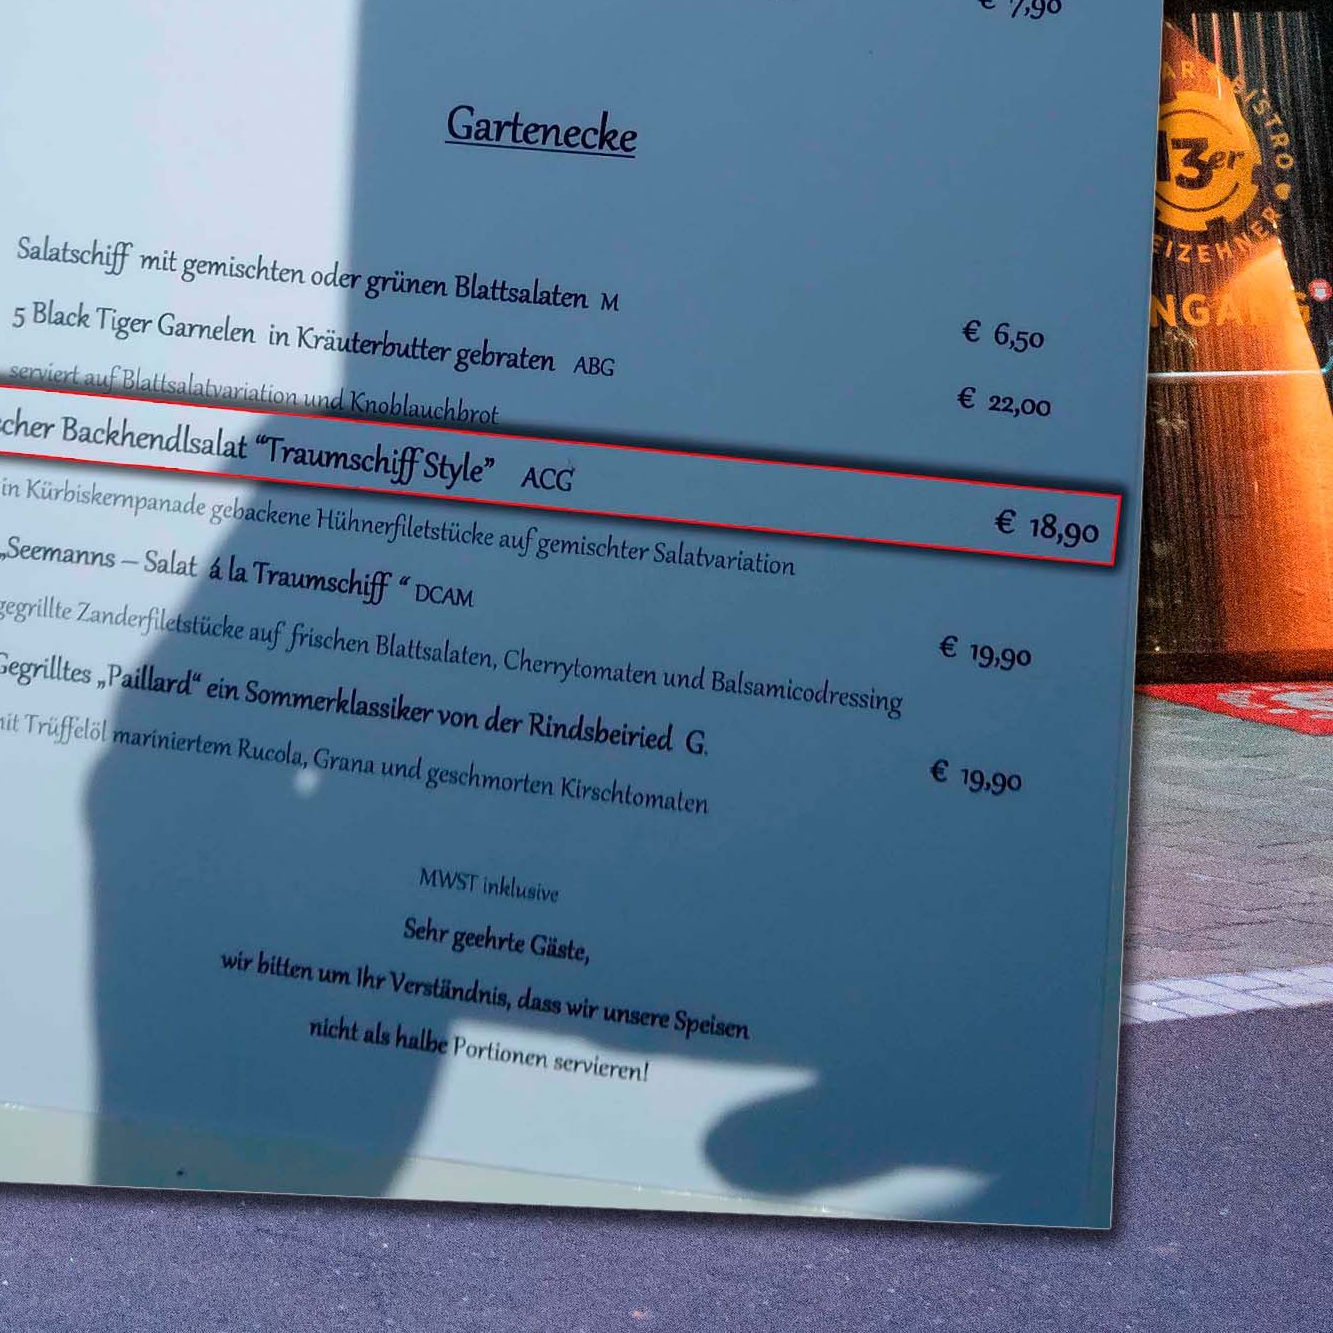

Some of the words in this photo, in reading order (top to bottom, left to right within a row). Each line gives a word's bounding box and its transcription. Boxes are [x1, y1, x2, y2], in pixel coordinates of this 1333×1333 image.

[1162, 60, 1196, 79] AR
[445, 104, 638, 156] Gartenecke
[17, 234, 134, 277] Salatschiff
[139, 249, 178, 272] mit
[180, 254, 306, 285] gemischten
[310, 260, 363, 289] oder
[364, 270, 449, 300] grünen
[454, 272, 590, 309] Blattsalaten
[600, 292, 620, 312] M
[12, 307, 26, 329] 5
[32, 298, 91, 329] Black
[95, 306, 153, 341] Tiger
[157, 312, 257, 344] Garnelen
[268, 323, 291, 347] in
[296, 325, 453, 362] Kräuterbutter
[453, 338, 557, 373] gebraten
[572, 355, 616, 377] ABG
[961, 319, 982, 343] €
[994, 322, 1045, 354] 6,50
[9, 360, 80, 387] serviert
[83, 363, 122, 394] auf
[122, 368, 298, 407] Blattsalatvariation
[303, 387, 344, 412] und
[350, 390, 501, 426] Knoblauchbrot
[956, 386, 977, 410] €
[988, 394, 1052, 418] 22,00
[61, 416, 248, 460] Backhendlsalat
[520, 466, 576, 492] ACG
[1, 477, 21, 498] in
[26, 478, 206, 517] Kürbiskernpanade
[209, 497, 311, 527] gebackene
[316, 507, 495, 549] Hühnerfiletstücke
[499, 527, 538, 558] auf
[535, 533, 651, 563] gemischter
[653, 540, 796, 576] Salatvariation
[994, 508, 1017, 535] €
[1029, 513, 1100, 549] 18,90
[143, 549, 198, 578] Salat
[228, 554, 249, 584] la
[252, 560, 393, 606] Traumschiff
[415, 583, 474, 608] DCAM
[76, 601, 245, 640] Zanderfiletstücke
[248, 619, 286, 650] auf
[287, 622, 370, 656] frischen
[375, 632, 499, 670] Blattsalaten,
[503, 647, 657, 686] Cherrytomaten
[663, 665, 706, 691] und
[711, 669, 904, 720] Balsamicodressing
[938, 635, 959, 658] €
[969, 643, 1032, 672] 19,90
[206, 677, 241, 701] ein
[244, 679, 435, 723] Sommerklassiker
[436, 709, 480, 730] von
[484, 705, 524, 734] der
[528, 712, 674, 753] Rindsbeiried
[685, 729, 708, 756] G.
[24, 713, 107, 745] Trüffelöl
[112, 729, 232, 757] mariniertem
[237, 737, 308, 770] Rucola,
[313, 747, 375, 775] Grana
[381, 756, 423, 780] und
[424, 761, 554, 796] geschmorten
[561, 776, 708, 815] Kirschtomaten
[929, 758, 950, 783] €
[960, 768, 1022, 797] 19,90
[419, 867, 479, 893] MWST
[483, 875, 559, 903] inklusive
[403, 916, 450, 944] Sehr
[451, 924, 526, 955] geehrte
[529, 933, 590, 966] Gäste,
[220, 950, 254, 973] wir
[256, 950, 315, 982] bitten
[318, 967, 352, 986] um
[356, 964, 387, 991] Ihr
[389, 970, 512, 1012] Verständnis,
[517, 986, 562, 1015] dass
[565, 997, 600, 1019] wir
[603, 1006, 671, 1029] unsere
[673, 1009, 750, 1041] Speisen
[309, 1015, 359, 1042] nicht
[362, 1020, 391, 1047] als
[395, 1023, 448, 1053] halbe
[453, 1035, 548, 1069] Portionen
[553, 1055, 649, 1082] servieren!
